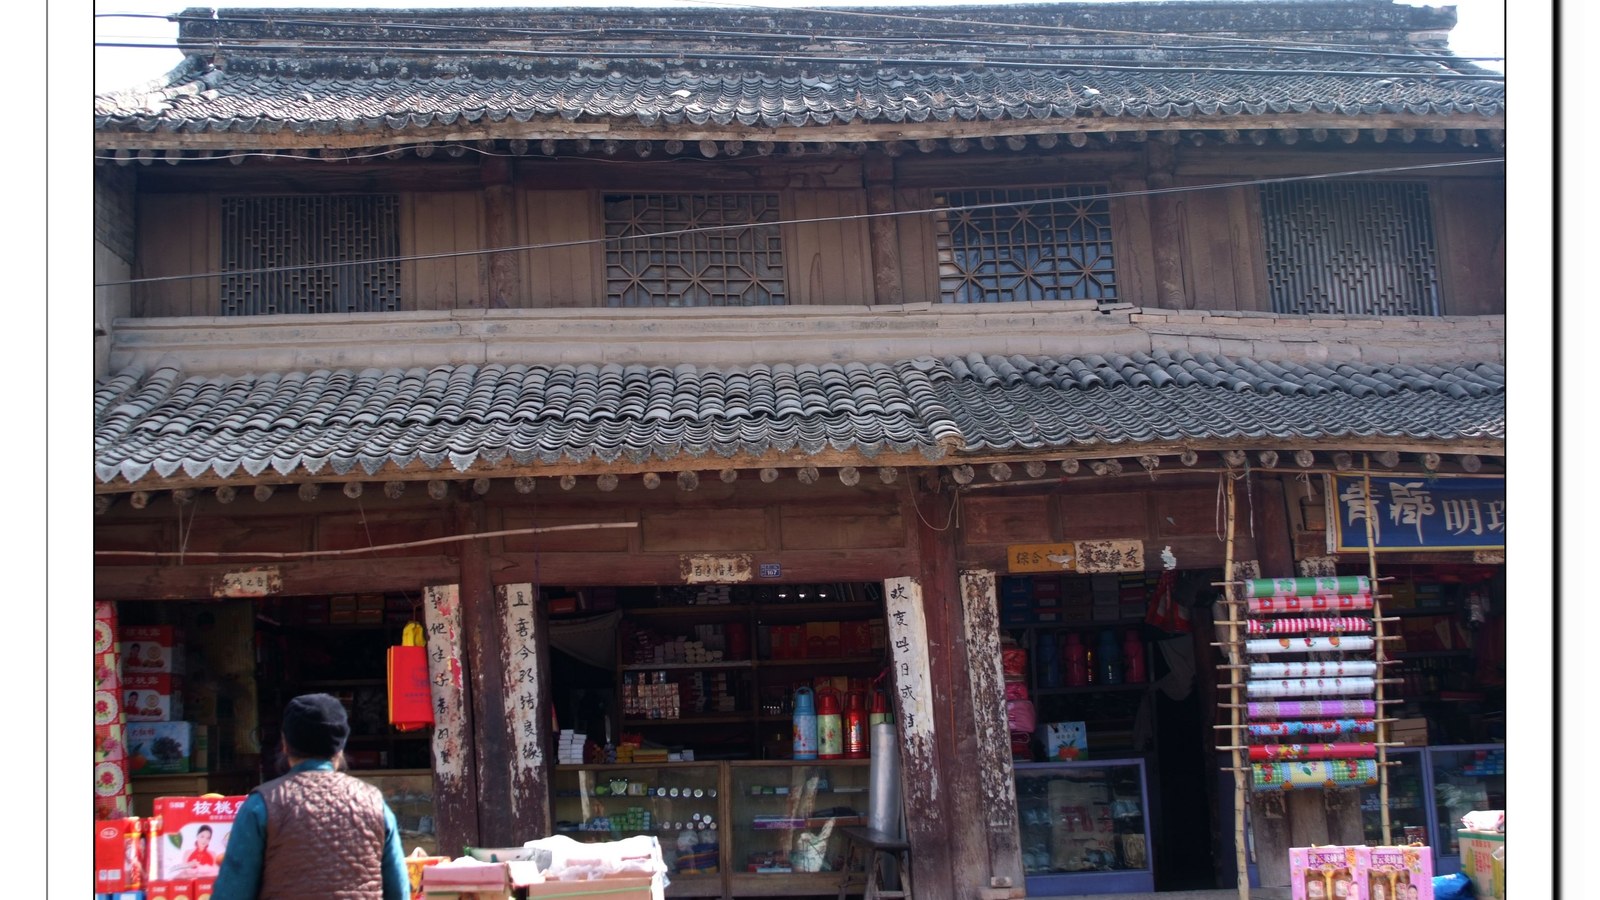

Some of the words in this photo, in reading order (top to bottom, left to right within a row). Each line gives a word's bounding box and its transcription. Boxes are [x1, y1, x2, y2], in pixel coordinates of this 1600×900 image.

[890, 583, 917, 749] 欢度此日成佳
